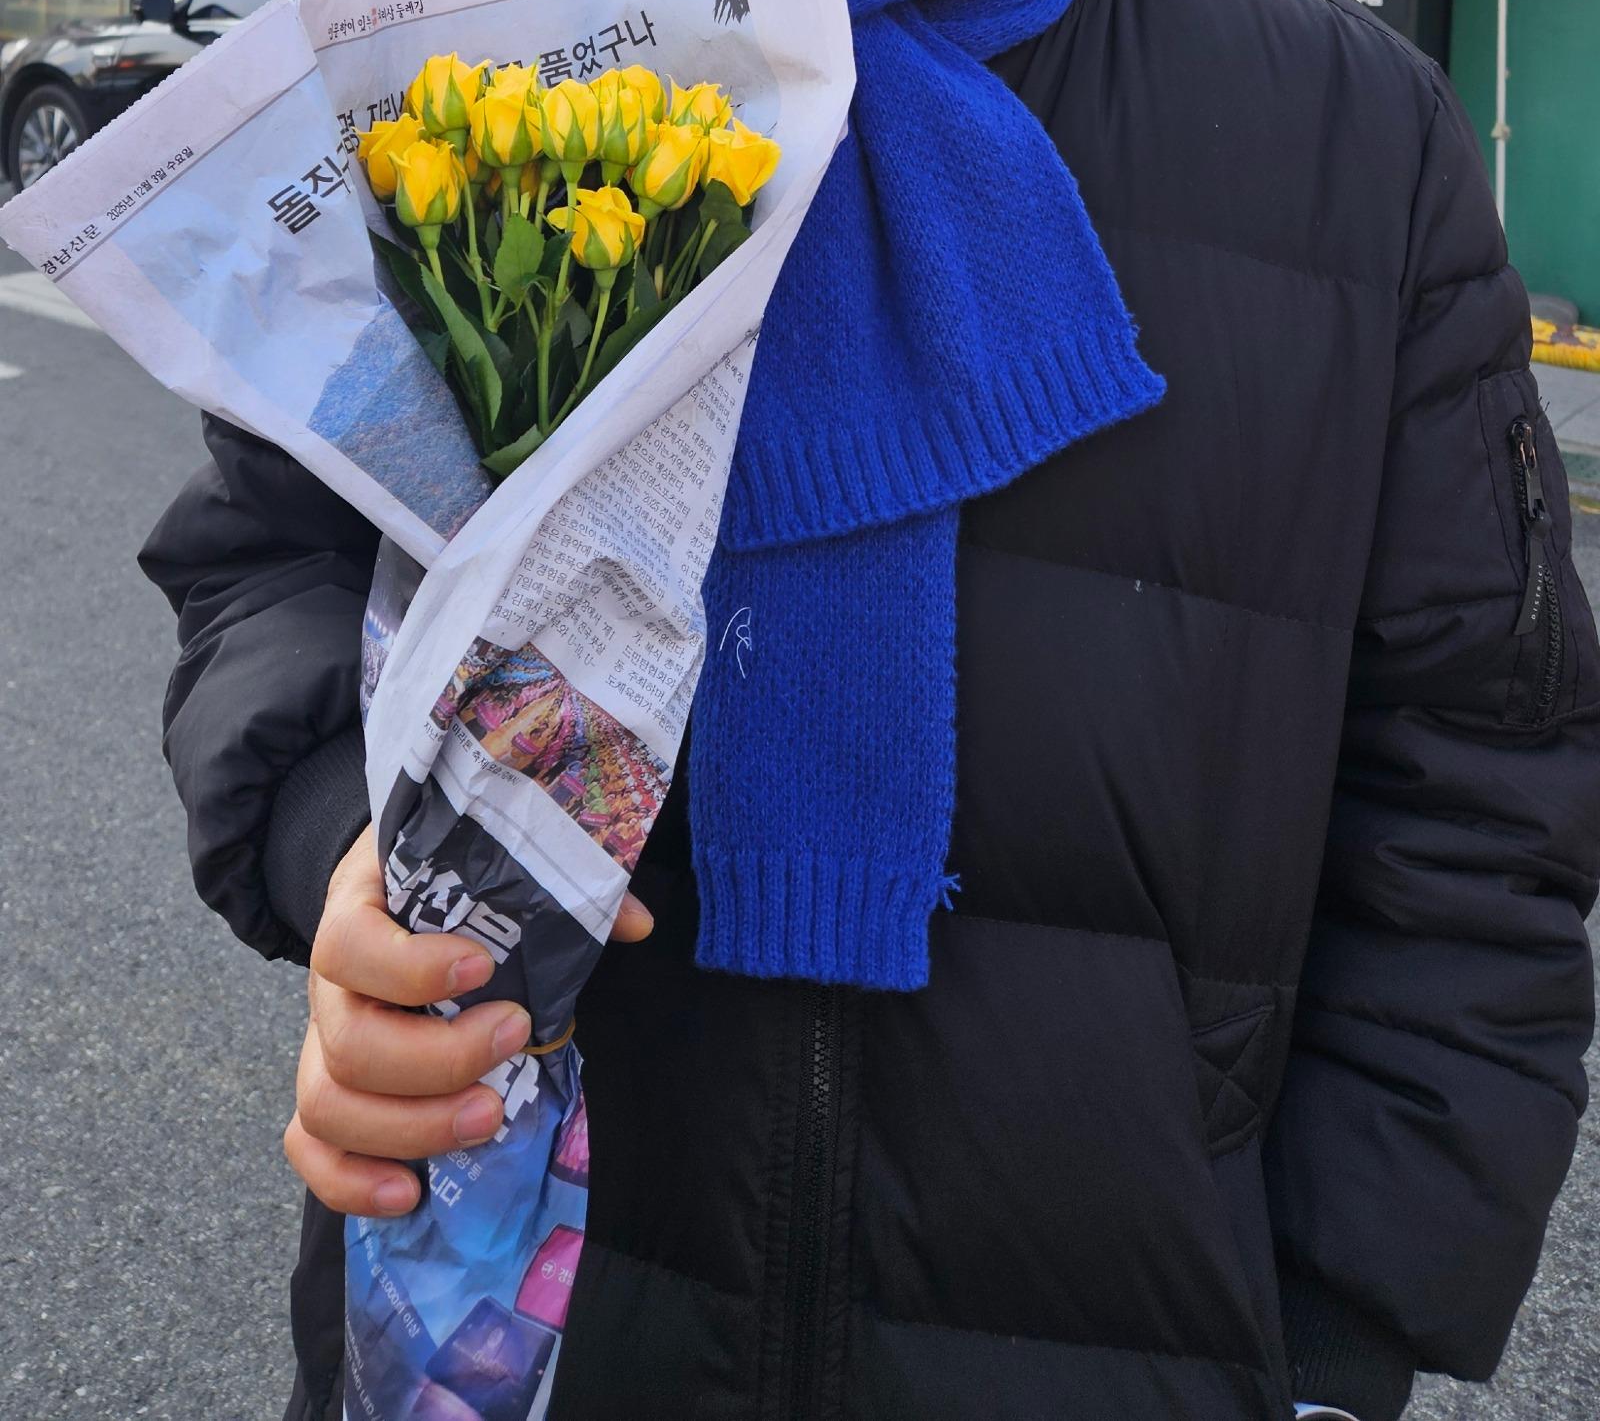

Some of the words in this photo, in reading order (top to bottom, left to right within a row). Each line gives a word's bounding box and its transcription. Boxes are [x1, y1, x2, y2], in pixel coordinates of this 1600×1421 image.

[538, 10, 658, 90] 품었구나
[41, 224, 101, 275] 경남신문
[106, 195, 136, 221] 2025년
[133, 179, 154, 199] 12월
[151, 168, 168, 184] 3일
[166, 145, 195, 171] 수요일
[652, 439, 670, 458] 이는
[659, 425, 696, 460] 관계자들이
[632, 442, 656, 465] 것으로
[653, 460, 687, 494] 예상된다.
[556, 513, 598, 540] 동호인이
[530, 540, 553, 558] 가는
[553, 552, 592, 575] 종목으로
[559, 535, 593, 555] 음악에
[515, 574, 553, 599] 7일에는
[535, 563, 568, 585] 경험을
[510, 592, 542, 612] 김해시
[451, 723, 472, 751] 마라톤
[470, 749, 489, 769] 축제
[428, 1161, 463, 1208] 니다
